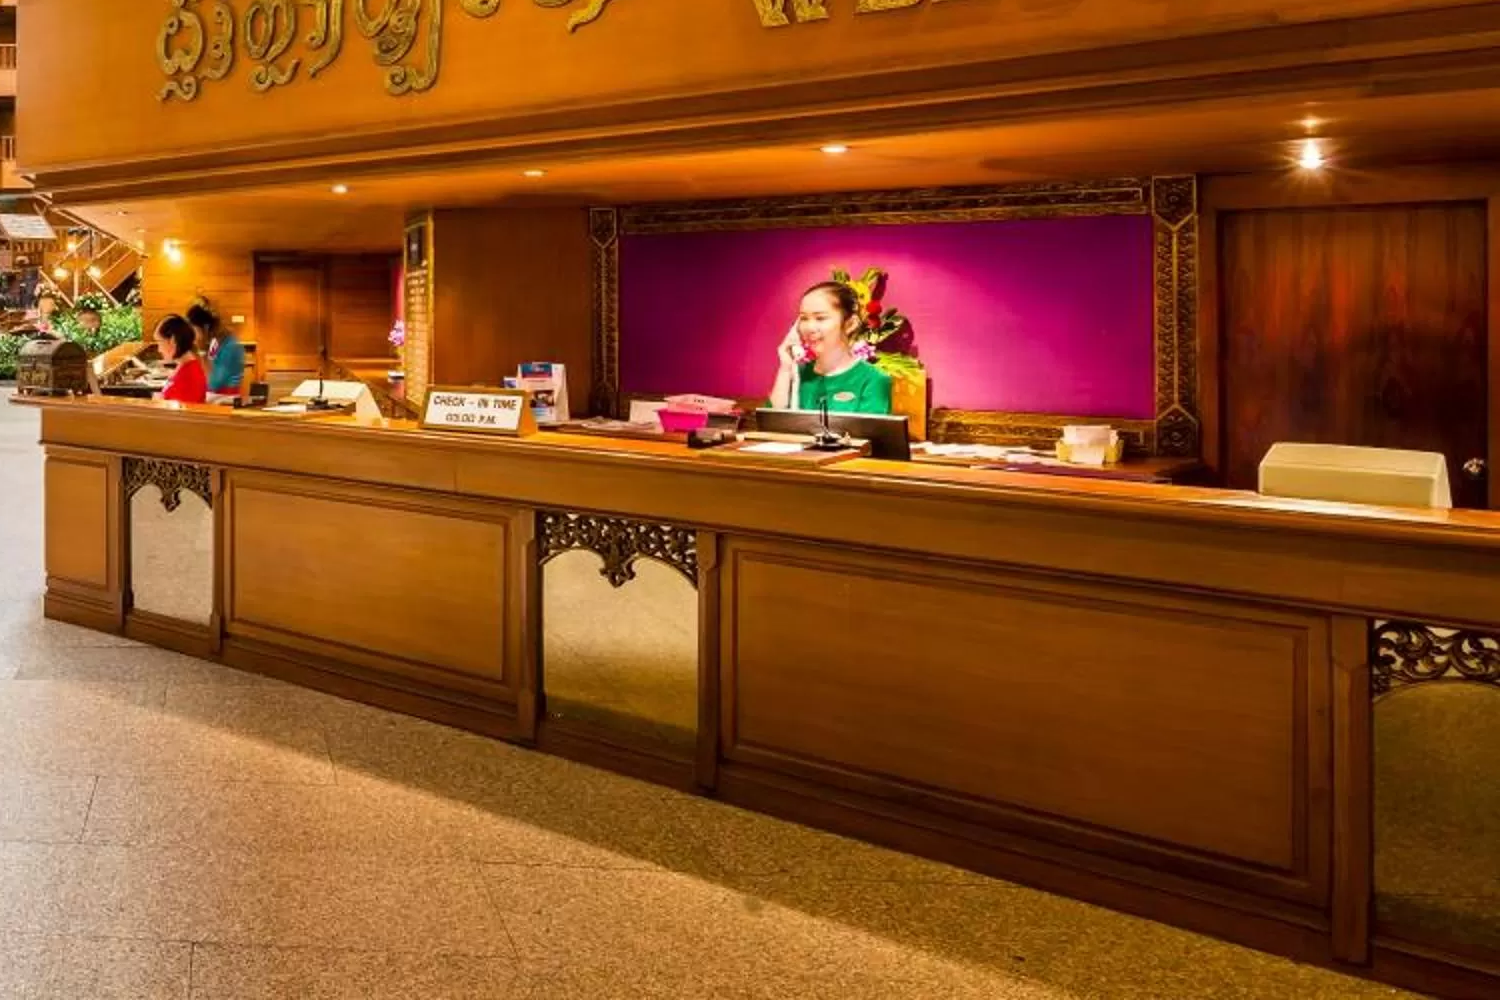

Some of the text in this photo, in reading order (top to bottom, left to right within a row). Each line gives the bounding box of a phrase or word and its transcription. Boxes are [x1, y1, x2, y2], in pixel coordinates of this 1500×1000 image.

[433, 395, 467, 407] CHECK
[477, 397, 490, 409] IN
[493, 399, 517, 411] TIME
